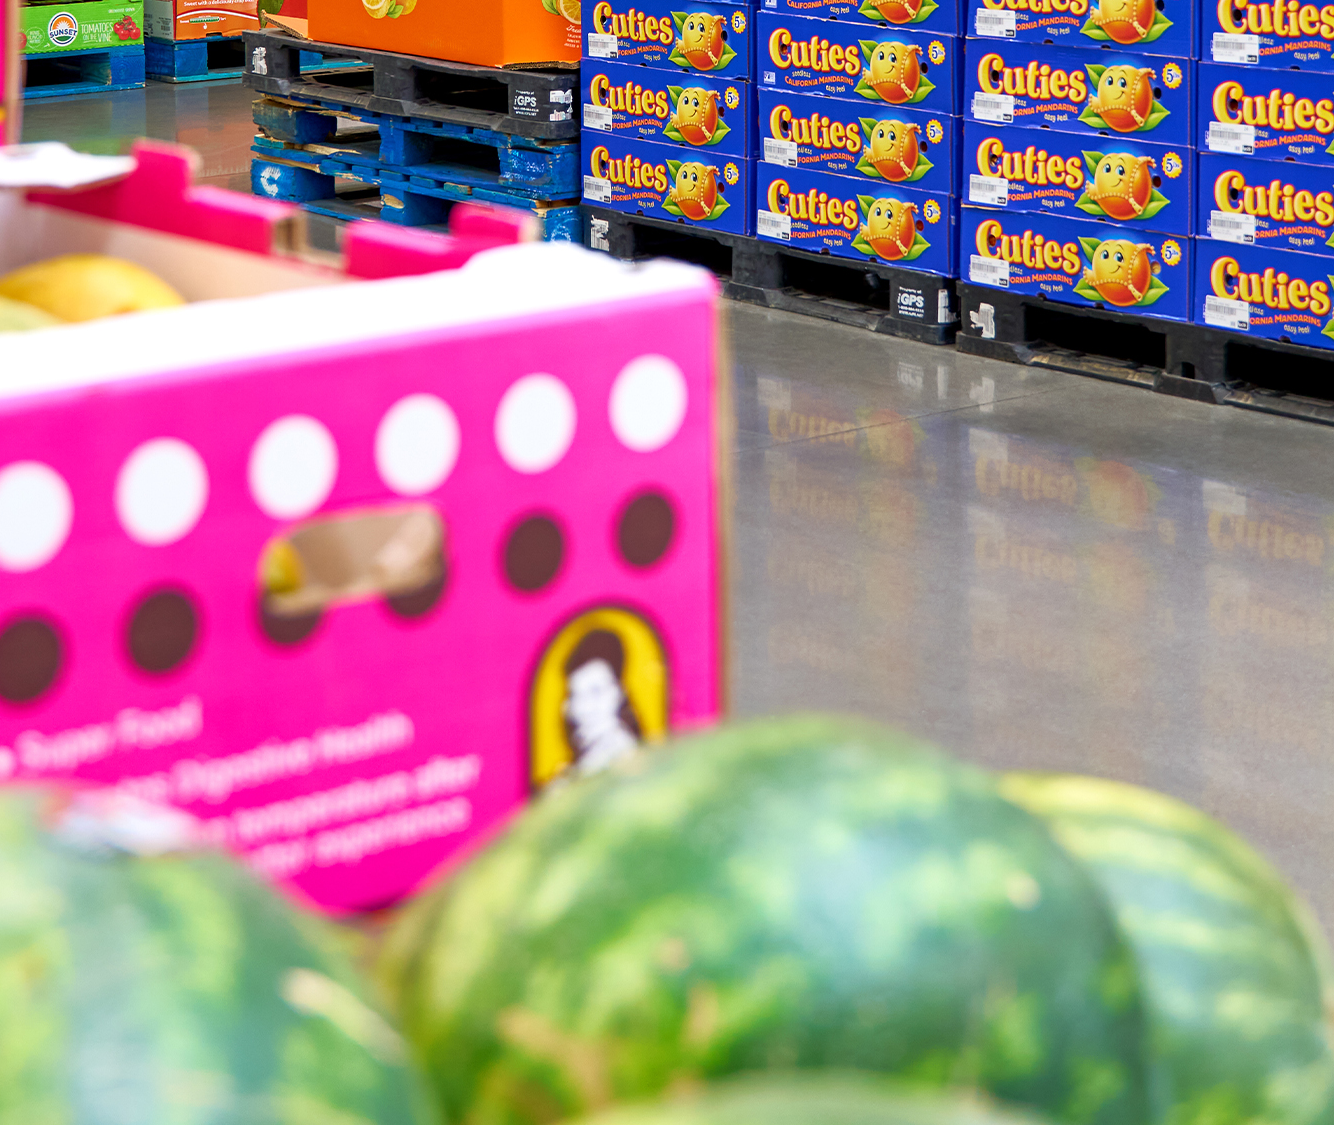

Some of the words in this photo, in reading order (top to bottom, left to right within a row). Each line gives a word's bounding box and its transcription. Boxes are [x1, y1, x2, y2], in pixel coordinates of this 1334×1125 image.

[48, 27, 78, 39] SUNSET
[81, 22, 114, 35] TOMATOES
[593, 1, 674, 47] Cuties
[768, 27, 861, 75] Cuties
[513, 95, 537, 108] iGPS
[590, 73, 669, 120] Cuties
[977, 53, 1087, 103] Cuties
[770, 104, 862, 154] Cuties
[590, 145, 668, 193] Cuties
[976, 137, 1085, 190] Cuties
[767, 178, 859, 228] Cuties
[975, 219, 1081, 275] Cuties
[896, 291, 925, 308] iGPS
[1209, 255, 1331, 318] Cuties
[15, 727, 112, 769] Super
[115, 695, 204, 748] Food
[171, 737, 313, 804] Digestive
[313, 710, 415, 760] Health
